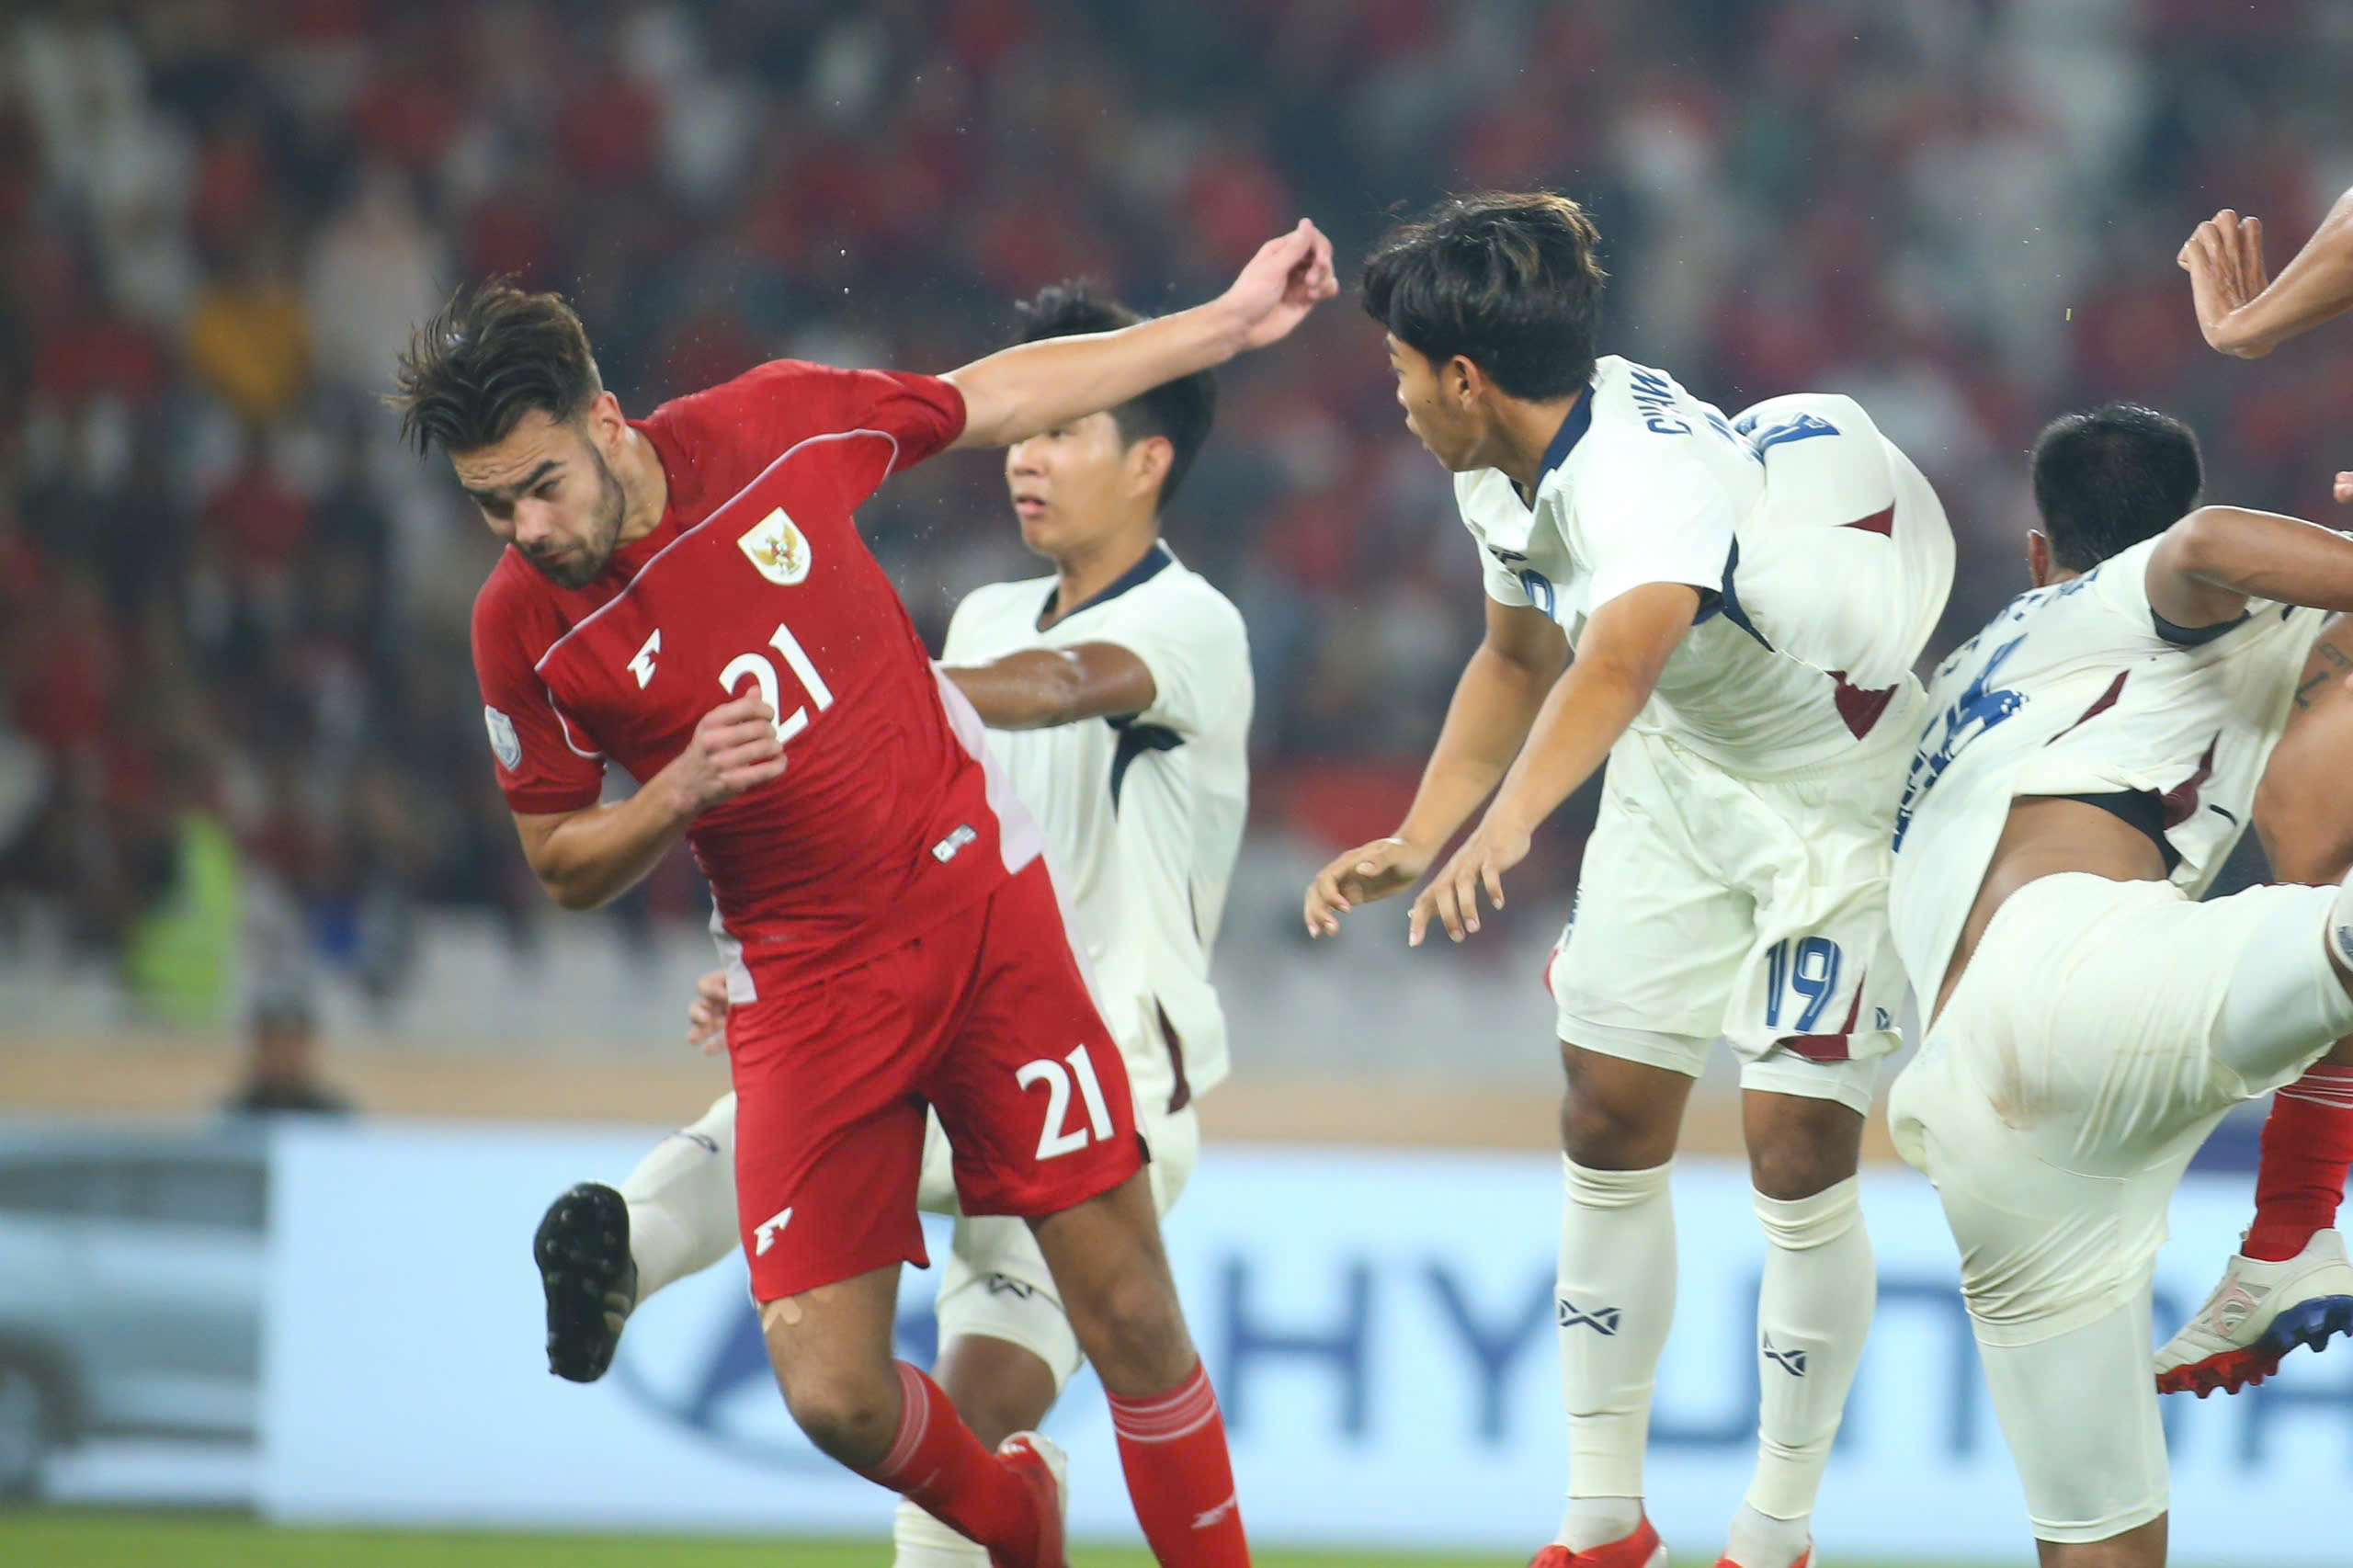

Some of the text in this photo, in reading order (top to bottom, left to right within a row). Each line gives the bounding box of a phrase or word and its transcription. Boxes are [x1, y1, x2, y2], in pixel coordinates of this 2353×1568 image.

[719, 622, 835, 744] 21
[1765, 936, 1843, 1033] 19
[1015, 1043, 1115, 1161] 21
